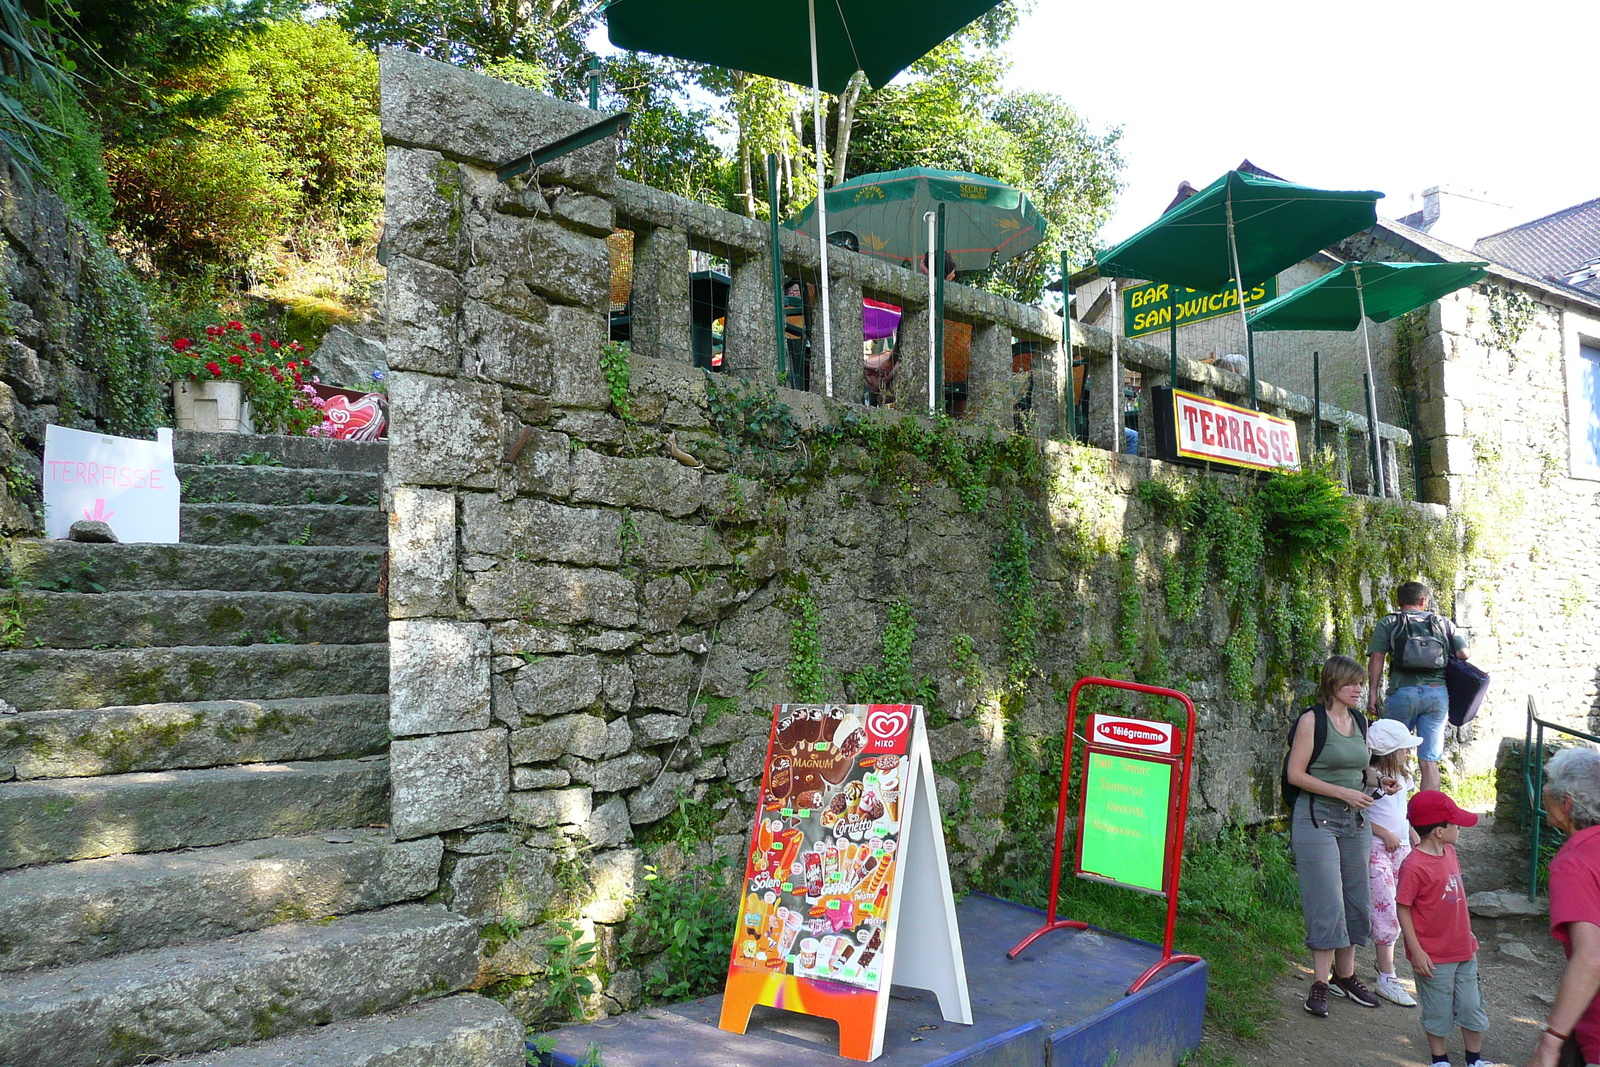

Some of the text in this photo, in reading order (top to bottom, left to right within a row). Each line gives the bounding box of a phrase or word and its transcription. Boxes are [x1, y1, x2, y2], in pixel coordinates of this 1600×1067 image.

[1131, 283, 1169, 308] BAR
[1133, 285, 1266, 330] SANDWICHES
[1183, 404, 1294, 463] TERRASSE
[47, 460, 164, 490] TERRASSE
[1101, 724, 1164, 742] Le Télégramme
[874, 739, 899, 748] MIKO
[792, 757, 835, 769] MAGNUM
[1093, 755, 1113, 770] BAR
[833, 818, 872, 838] Cornetto
[750, 874, 781, 891] Solero
